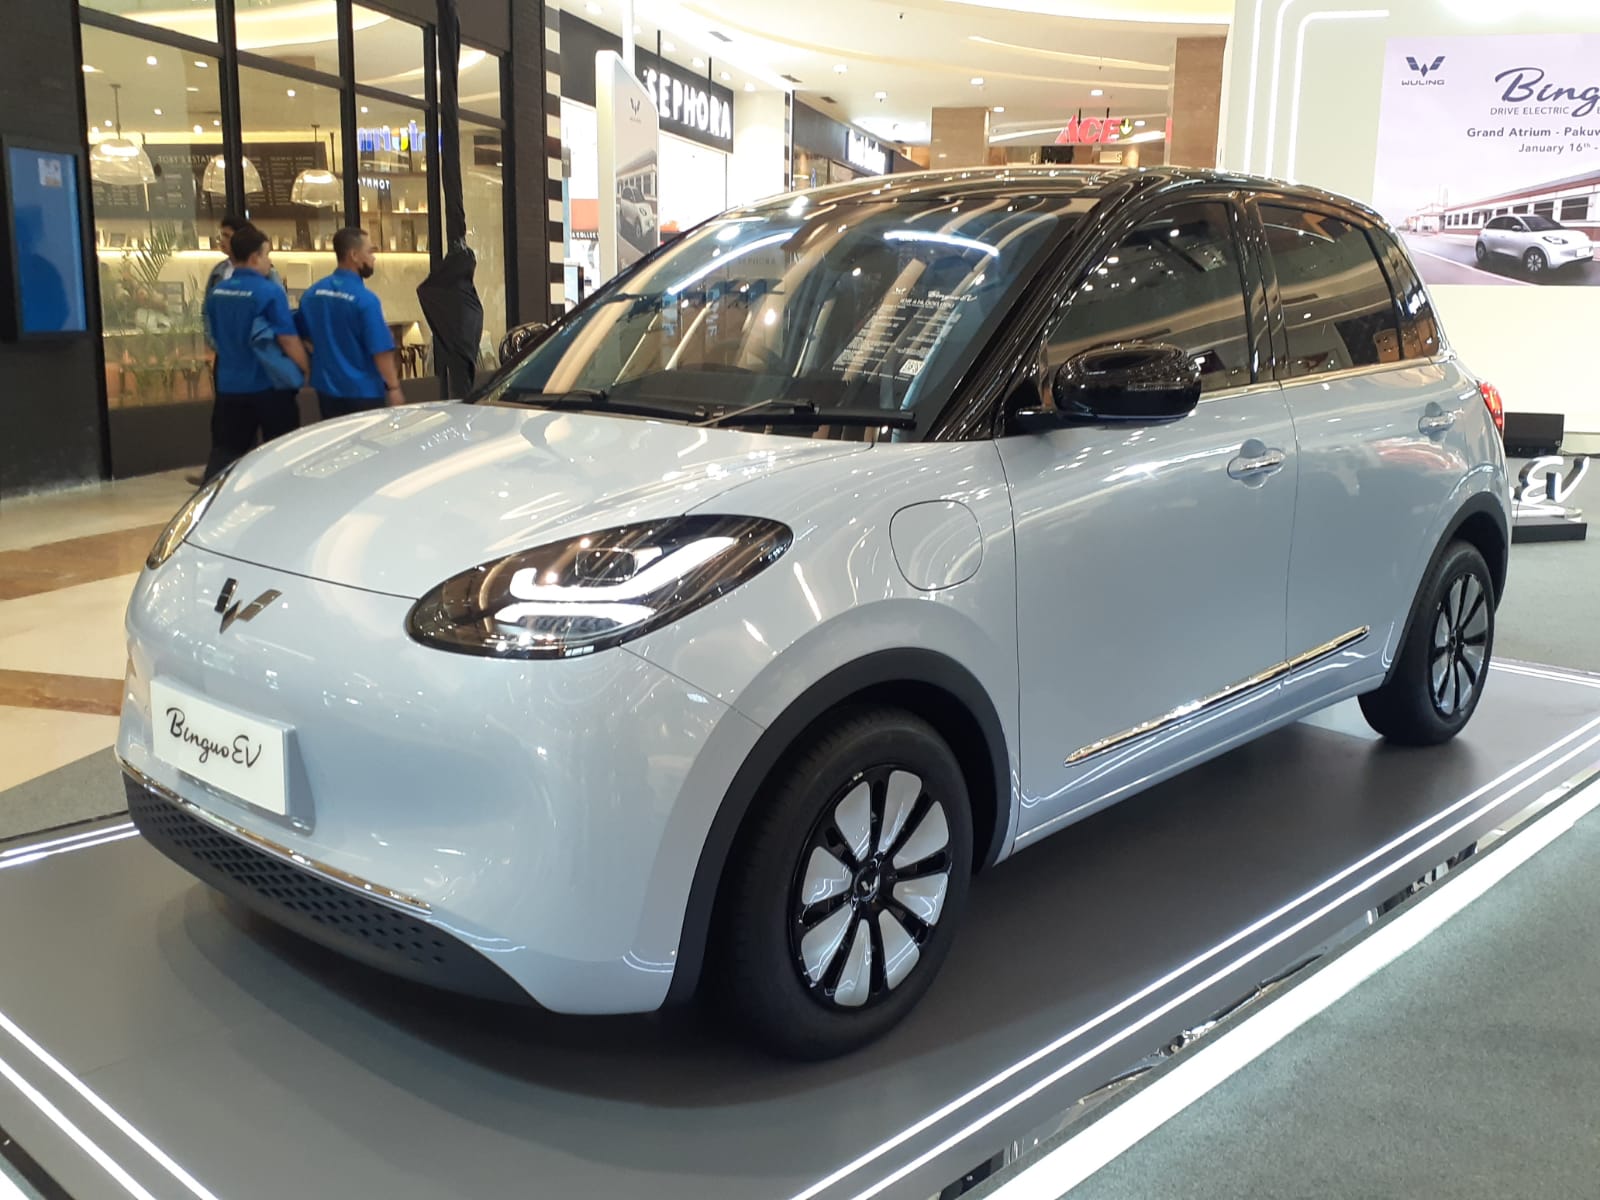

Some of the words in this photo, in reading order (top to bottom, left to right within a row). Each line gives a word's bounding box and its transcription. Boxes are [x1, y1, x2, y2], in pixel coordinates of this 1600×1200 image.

[643, 67, 732, 140] SEPHORA
[1490, 107, 1519, 115] DRIVE
[1522, 106, 1570, 115] ELECTRIC
[1055, 114, 1123, 144] ACE
[1466, 127, 1505, 137] Grand
[1508, 127, 1551, 137] Atrium
[1518, 143, 1565, 155] January
[166, 707, 230, 763] Binguo
